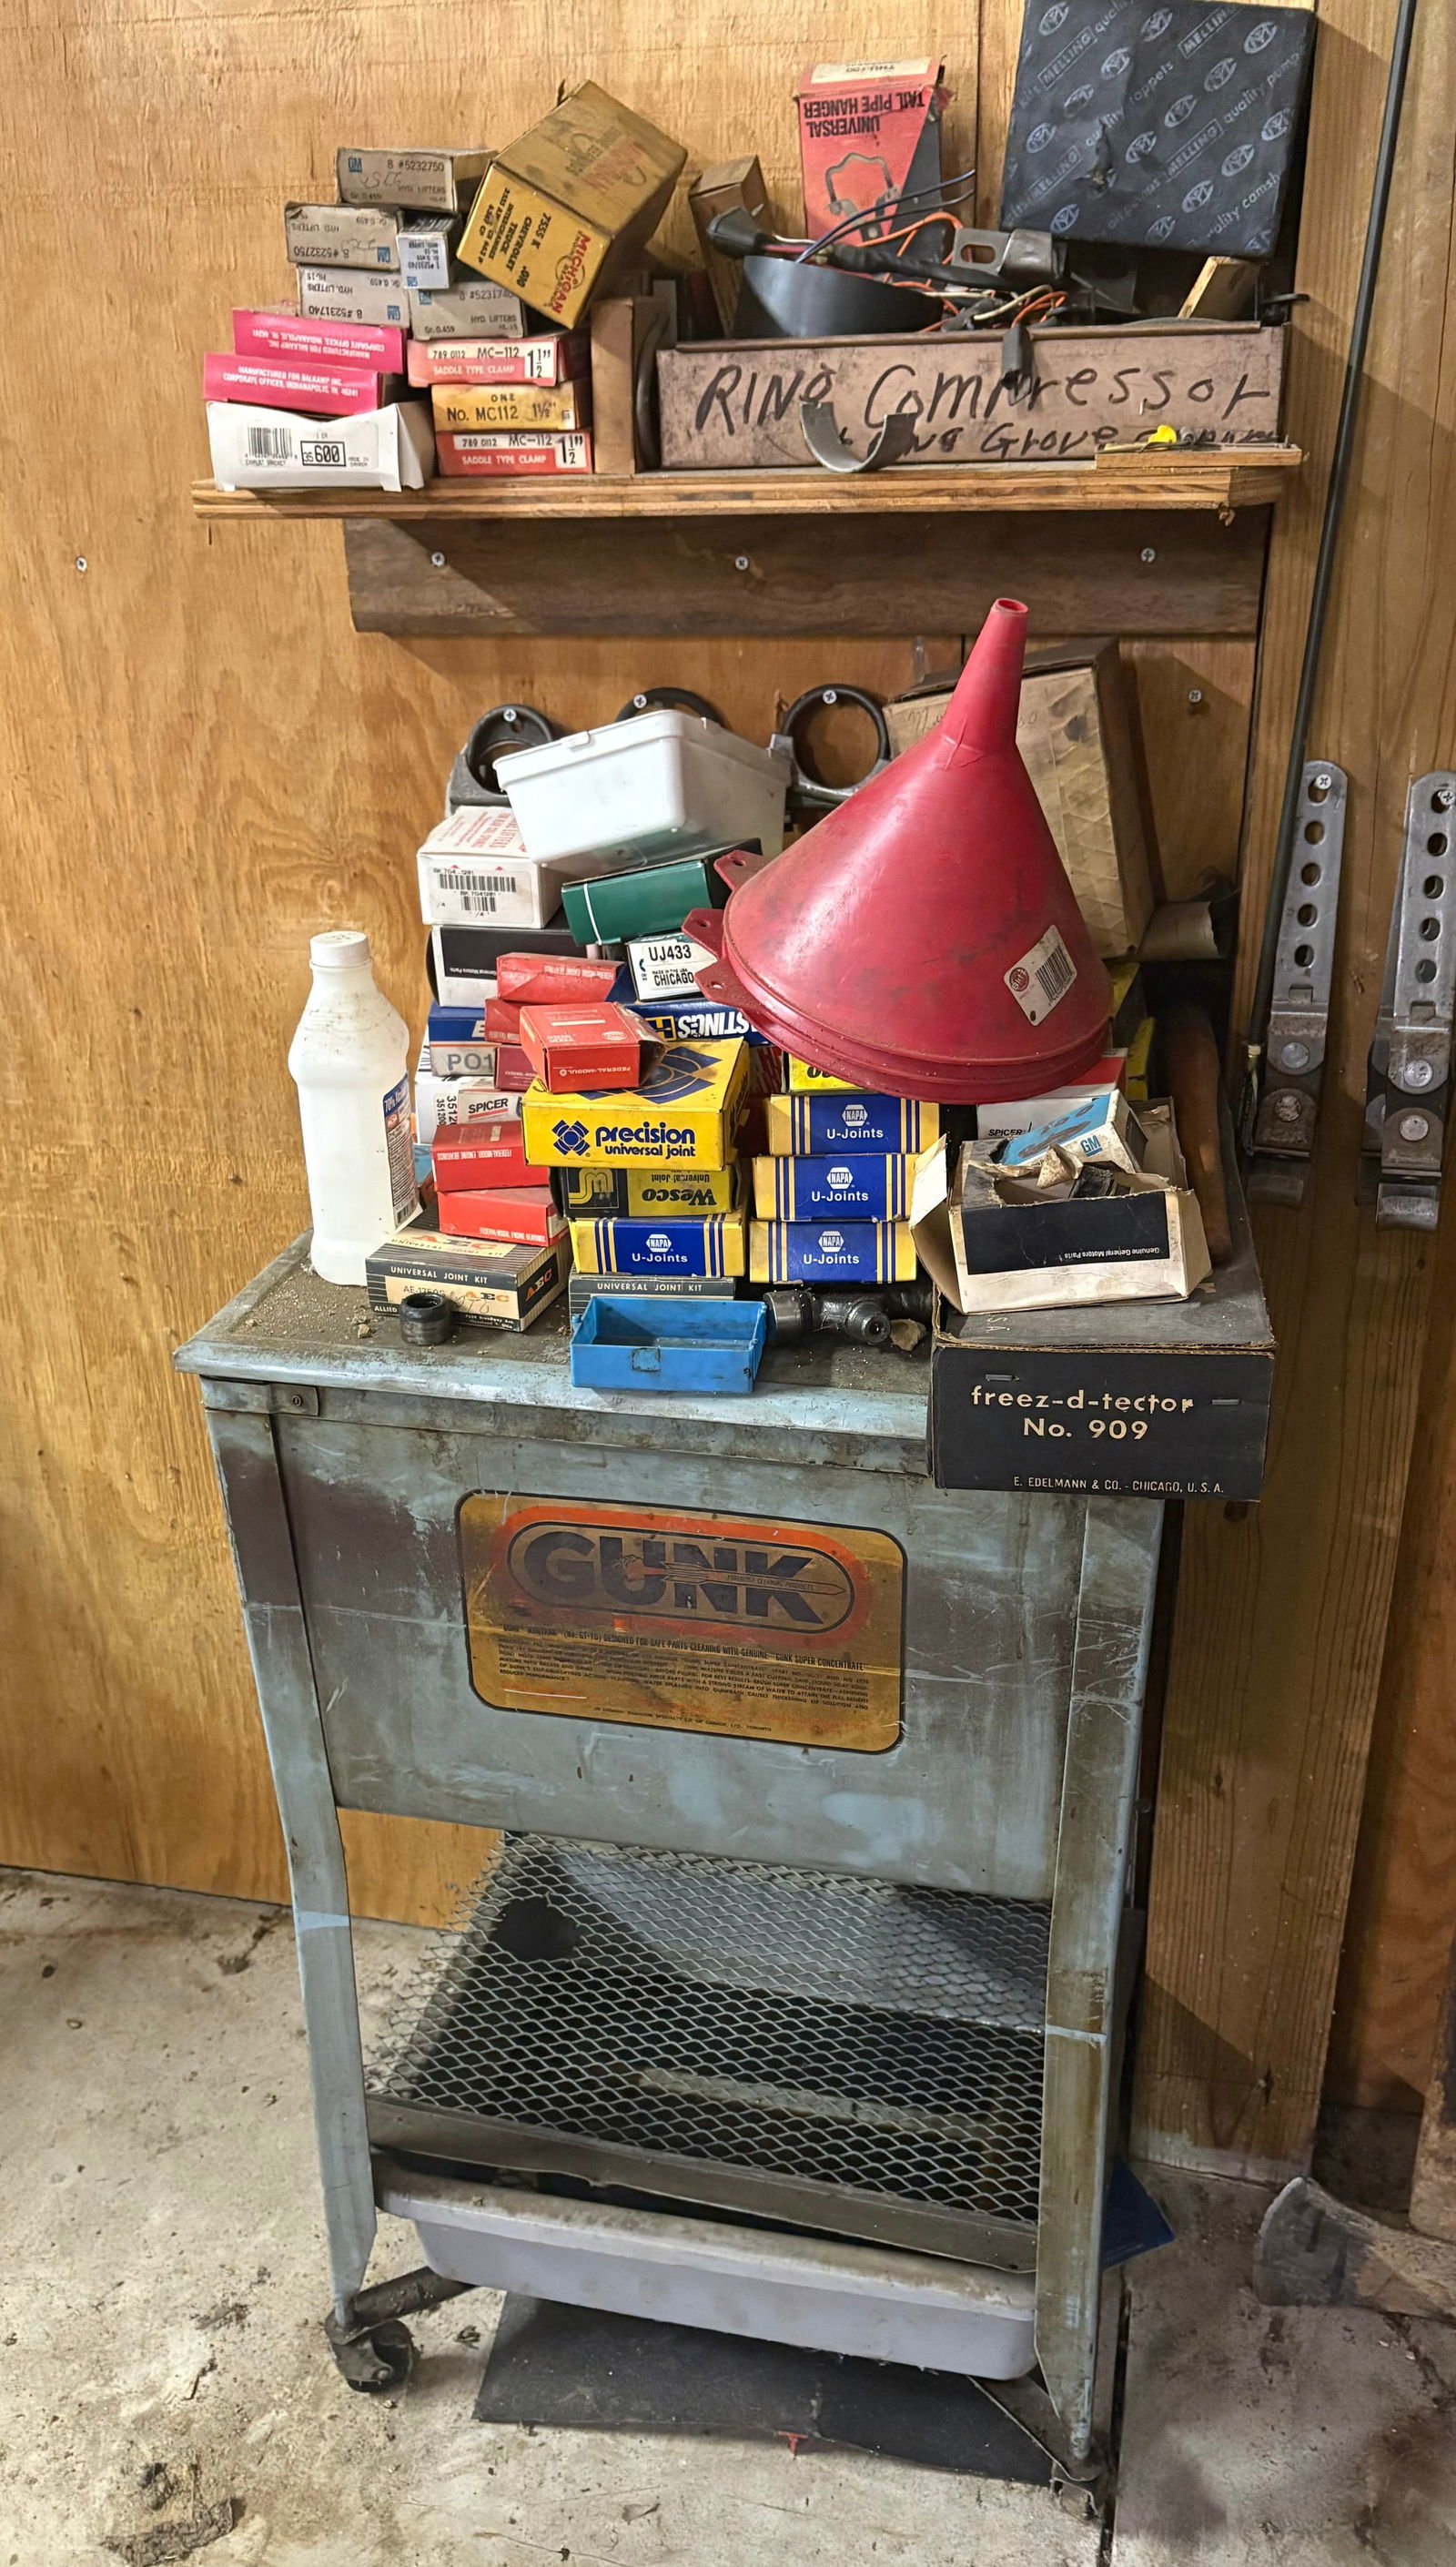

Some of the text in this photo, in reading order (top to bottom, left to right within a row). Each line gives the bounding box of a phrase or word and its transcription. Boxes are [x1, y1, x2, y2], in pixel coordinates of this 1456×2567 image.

[1042, 31, 1093, 85] MELLING
[803, 90, 925, 119] TAIL PIPE HANGER
[805, 114, 881, 138] UNIVERSAL
[500, 222, 518, 256] TRUCK
[506, 216, 532, 272] CHEVROLET
[551, 232, 592, 314] MICHIGAN
[308, 304, 353, 319] #5231740
[433, 350, 448, 360] 789
[476, 346, 520, 360] MC-112
[238, 365, 288, 380] MANUFACTURED
[300, 373, 330, 385] BALKAMP
[432, 364, 515, 375] SADDLE TYPE CLAMP
[490, 392, 516, 402] ONE
[475, 405, 520, 421] MC112
[461, 437, 478, 448] 789
[508, 434, 553, 447] MC-112
[462, 453, 547, 465] SADDLE TYPE CLAMP
[648, 944, 693, 962] UJ433
[653, 971, 695, 987] CHICAGO
[677, 1010, 758, 1040] STINGS
[468, 1097, 510, 1114] SPICER
[844, 1110, 865, 1121] NAPA
[594, 1121, 696, 1148] precision
[826, 1128, 885, 1140] U-Joints
[987, 1128, 1024, 1137] SPICER
[604, 1144, 696, 1161] universal joint
[1079, 1134, 1103, 1154] GM
[651, 1173, 672, 1183] Joint
[830, 1172, 850, 1184] NAPA
[642, 1188, 718, 1206] Wesco
[810, 1190, 869, 1202] U-Joints
[648, 1238, 670, 1250] NAPA
[822, 1236, 842, 1248] NAPA
[632, 1253, 689, 1263] U-Joints
[803, 1253, 861, 1265] U-Joints
[1064, 1246, 1160, 1260] Genuine General Motors Parts
[389, 1265, 489, 1285] UNIVERSAL JOINT KIT
[525, 1268, 554, 1302] AEC
[596, 1282, 703, 1293] UNIVERSAL JOINT KIT
[970, 1385, 1195, 1415] freez-d-tector
[1022, 1416, 1149, 1440] No. 909
[1013, 1476, 1024, 1487] E.
[1027, 1476, 1087, 1490] EDELMANN
[1091, 1479, 1100, 1490] &
[1104, 1480, 1122, 1491] CO.
[1187, 1482, 1198, 1493] U.
[1199, 1482, 1211, 1494] S.
[1213, 1482, 1225, 1494] A.
[523, 1530, 824, 1626] GUNK
[722, 1646, 739, 1657] WITH
[741, 1648, 768, 1659] GENUINE
[794, 1655, 816, 1666] SUPER
